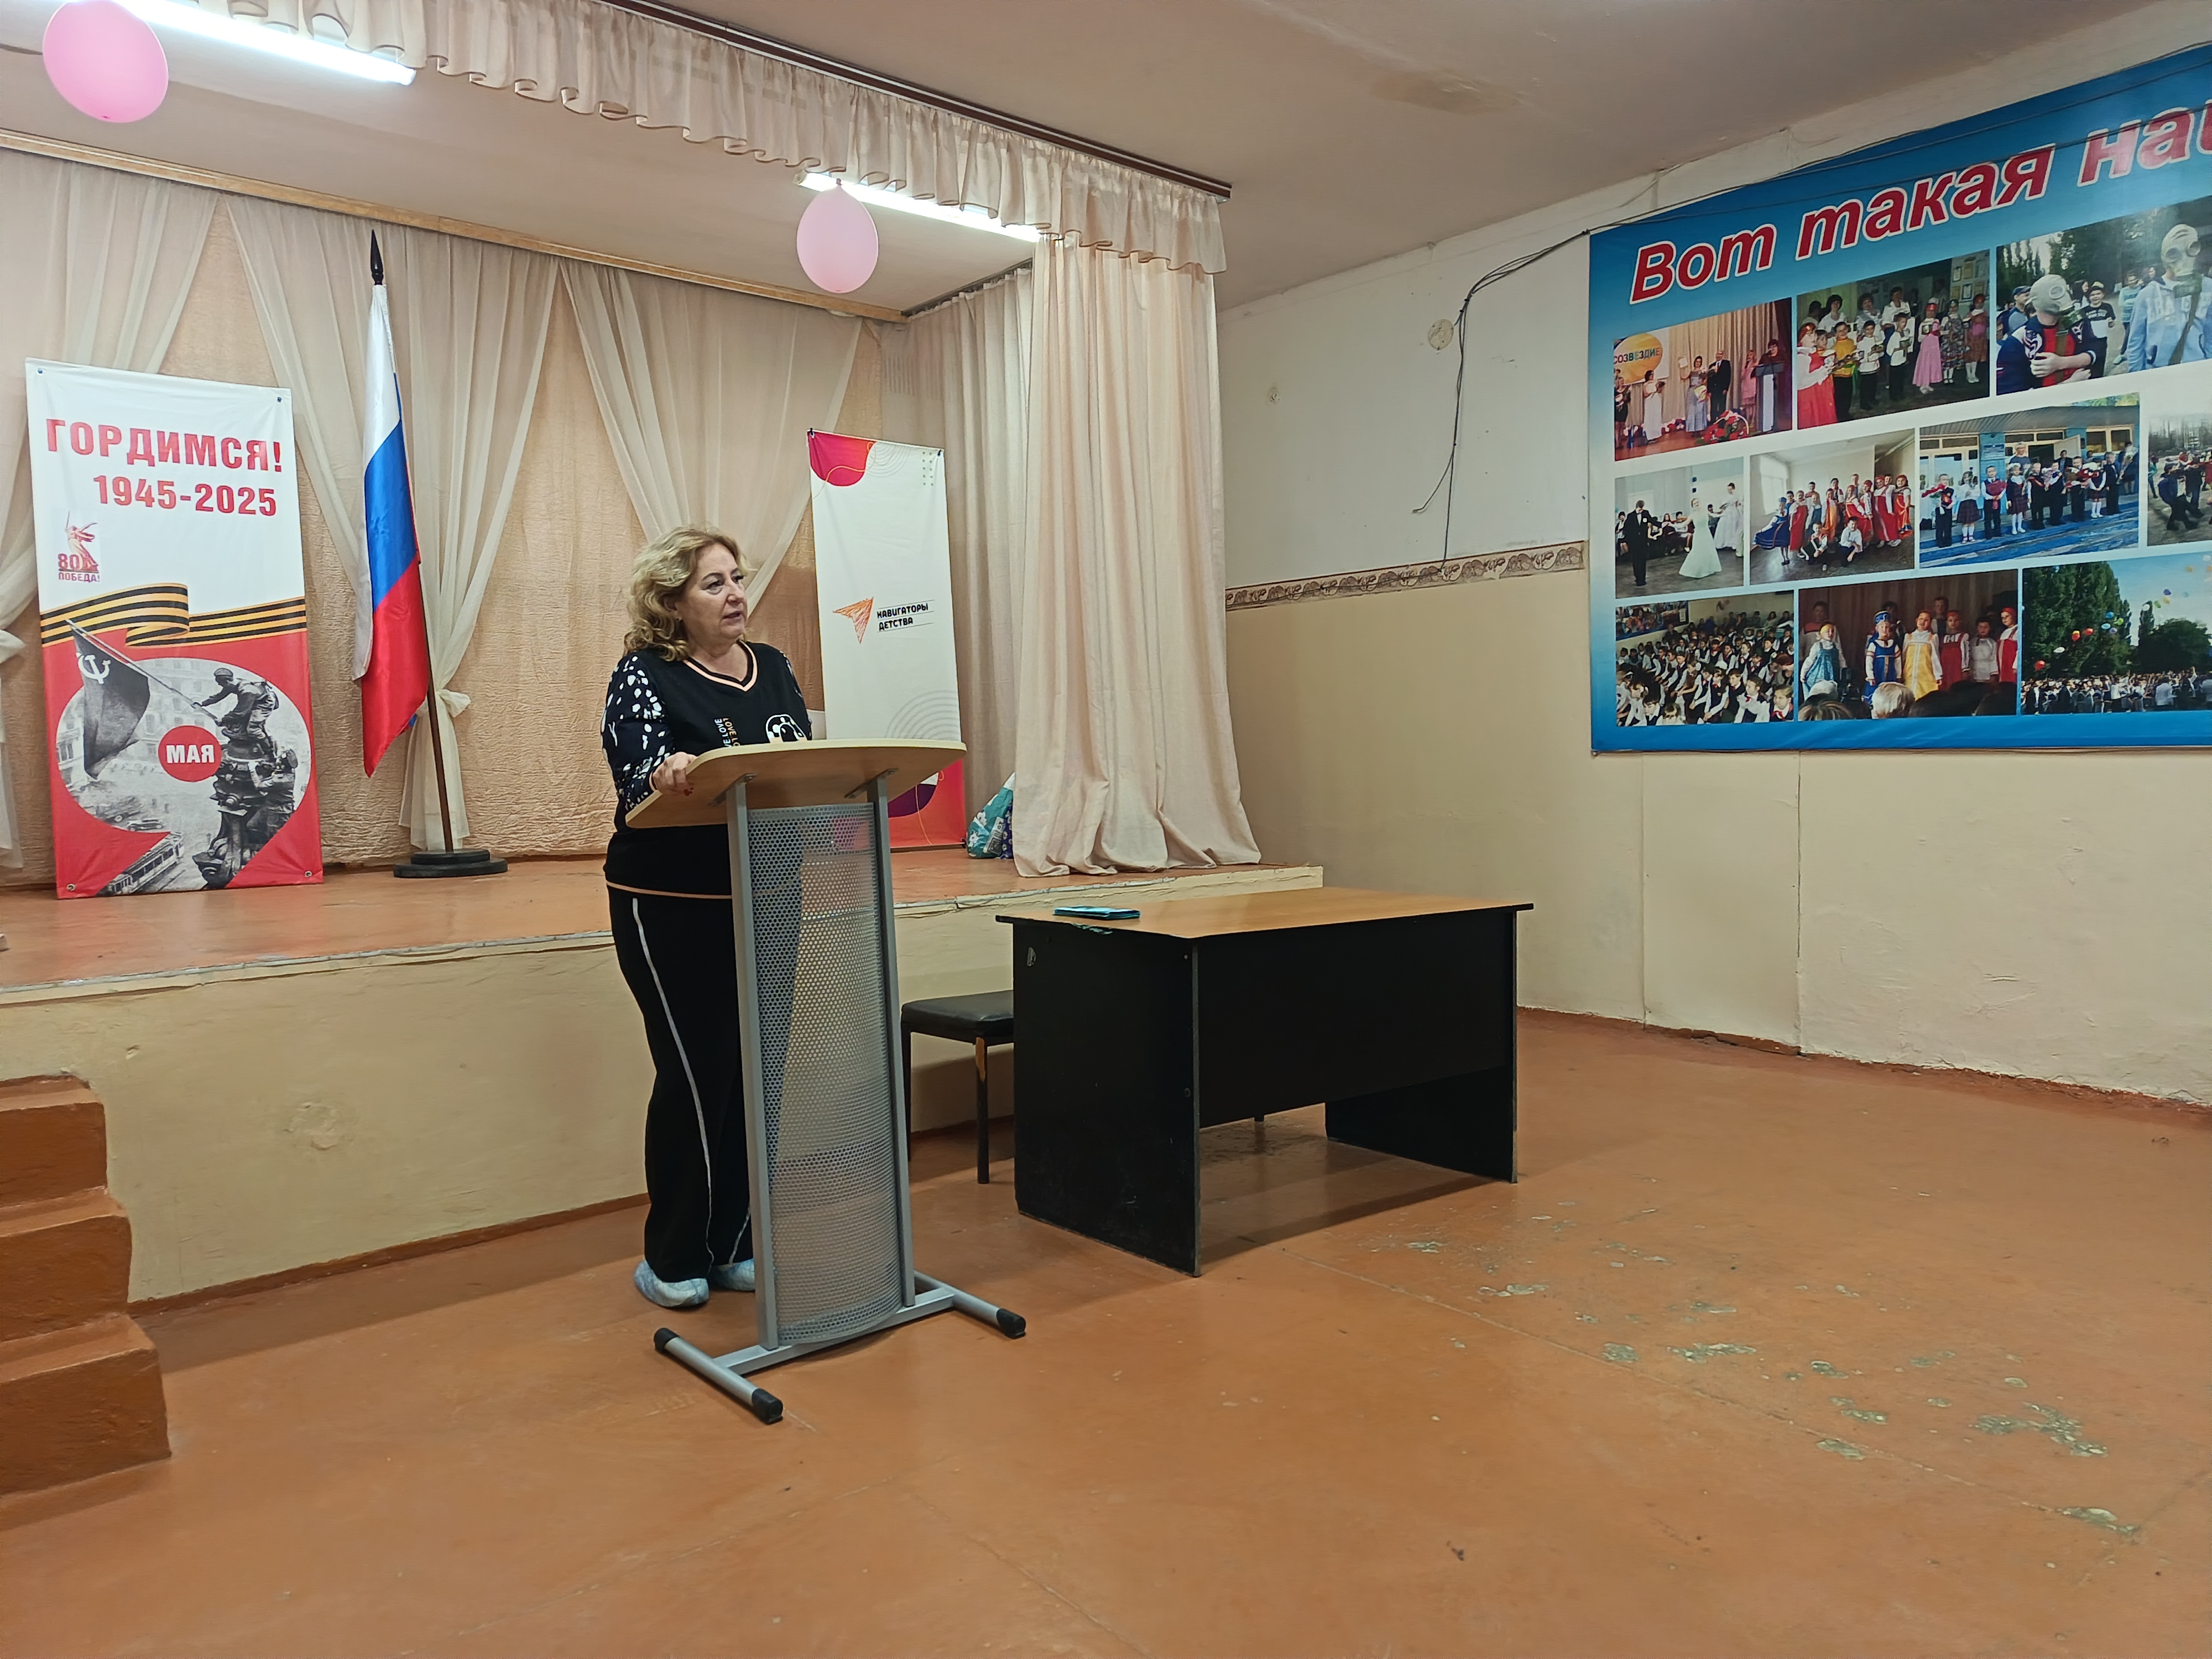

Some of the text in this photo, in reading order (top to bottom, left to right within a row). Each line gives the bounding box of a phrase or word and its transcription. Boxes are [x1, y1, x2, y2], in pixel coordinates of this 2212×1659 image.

[1630, 98, 2212, 305] Вот такая на
[46, 418, 282, 472] ГОРДИМСЯ!
[93, 474, 276, 517] 1945-2025
[58, 553, 80, 570] 80
[59, 572, 100, 583] ПОБЕДА!
[877, 603, 928, 619] НАВИГАТОРЫ
[879, 617, 913, 632] ДЕТСТВА
[166, 744, 215, 764] МАЯ
